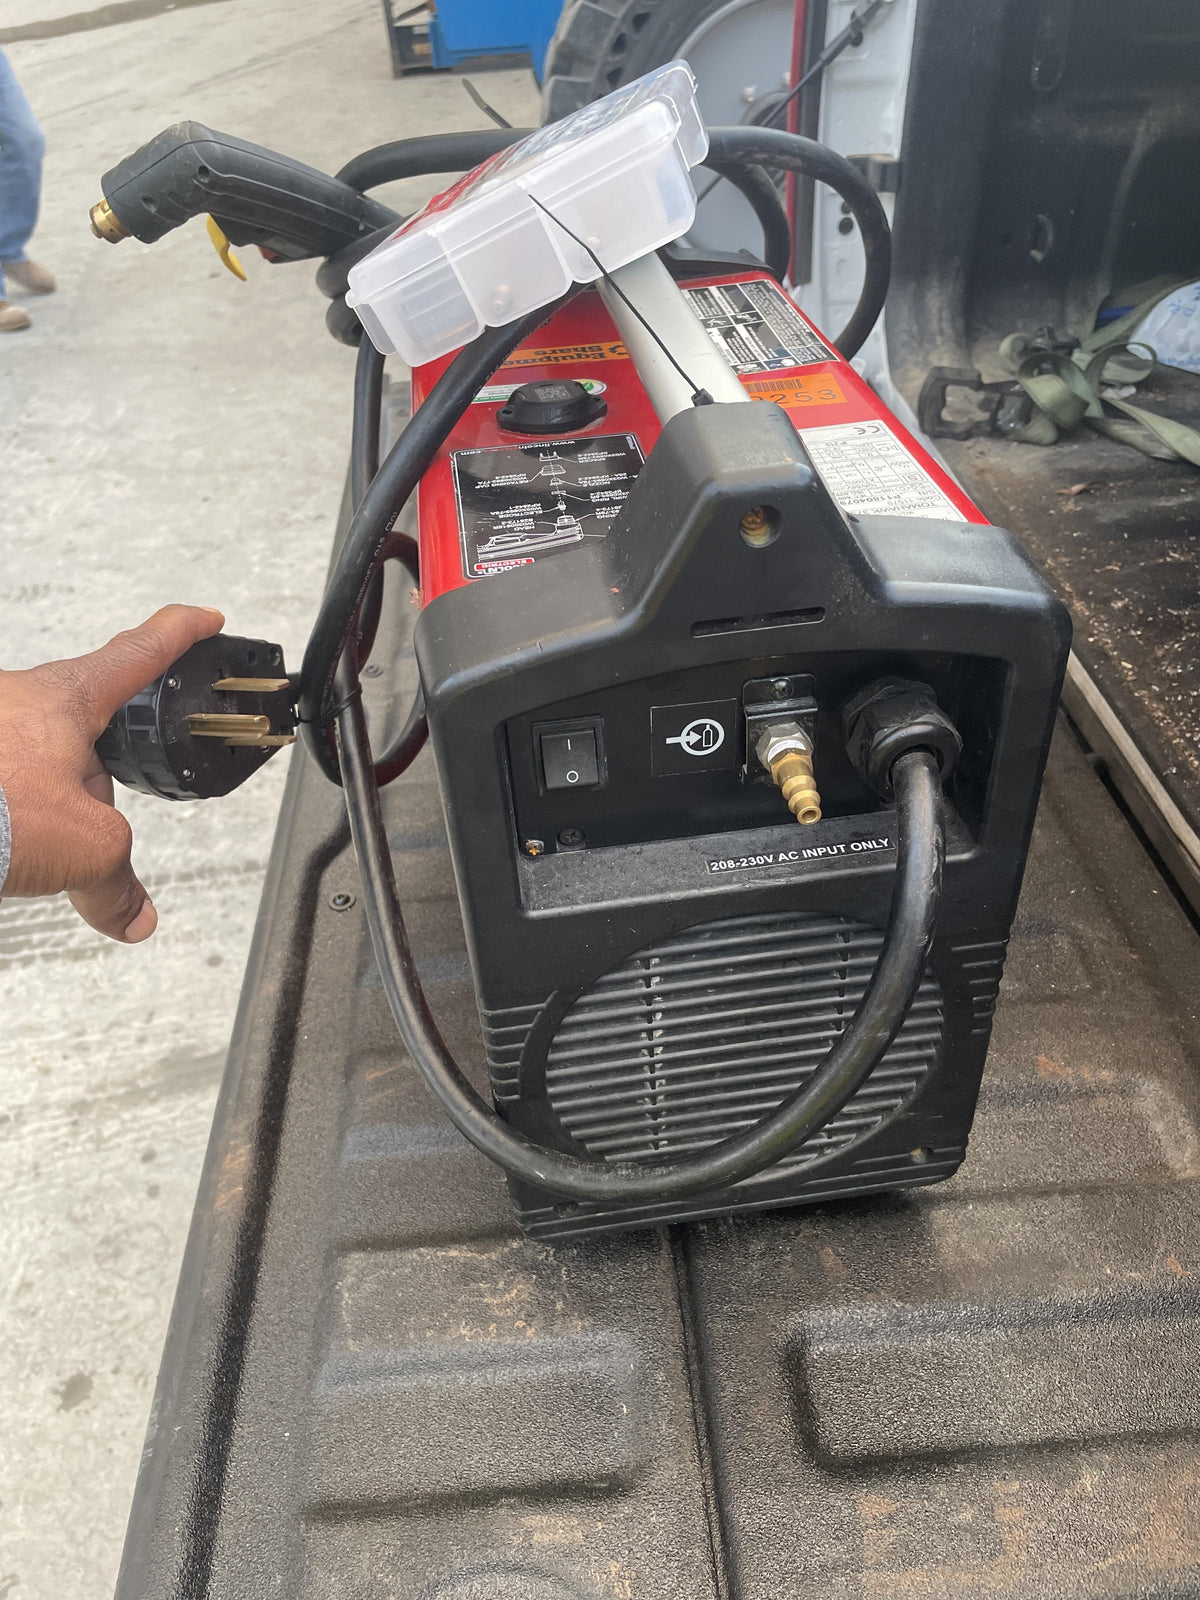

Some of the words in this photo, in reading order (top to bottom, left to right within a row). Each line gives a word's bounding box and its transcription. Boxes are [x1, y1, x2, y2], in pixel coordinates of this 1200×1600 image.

[534, 345, 603, 356] Share
[916, 494, 941, 502] Code
[872, 502, 936, 514] TOMAHAWK
[498, 510, 542, 518] ELECTRODE
[481, 560, 526, 568] ELECTRIC
[710, 854, 774, 871] 208-230V
[777, 851, 800, 862] AC
[801, 843, 847, 858] INPUT
[849, 837, 890, 851] ONLY
